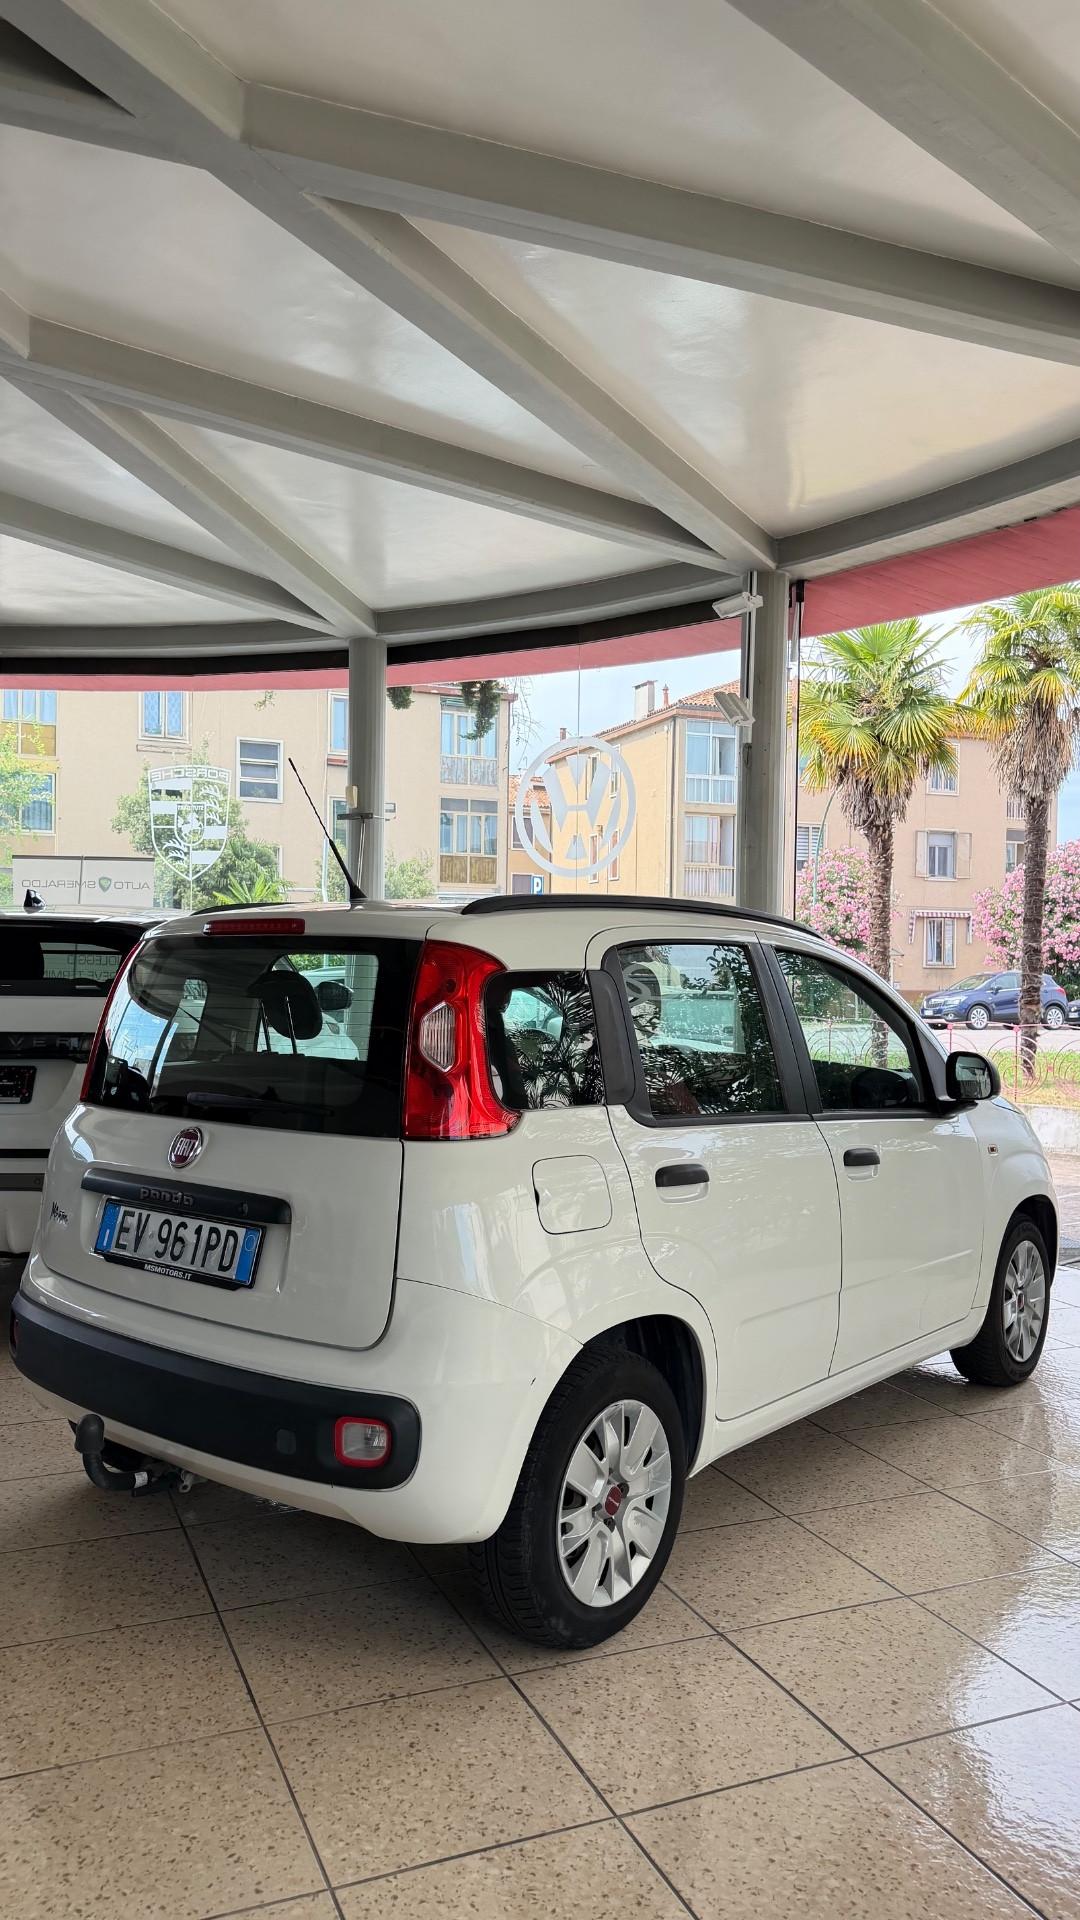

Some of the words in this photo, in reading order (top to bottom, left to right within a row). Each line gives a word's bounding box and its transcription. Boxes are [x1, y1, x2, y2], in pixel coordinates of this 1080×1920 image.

[533, 876, 542, 895] P
[173, 1137, 197, 1157] FIAT
[139, 1187, 194, 1208] panda
[115, 1210, 151, 1253] EV
[154, 1218, 239, 1272] 961PD
[144, 1264, 192, 1280] MSMOTORS.IT
